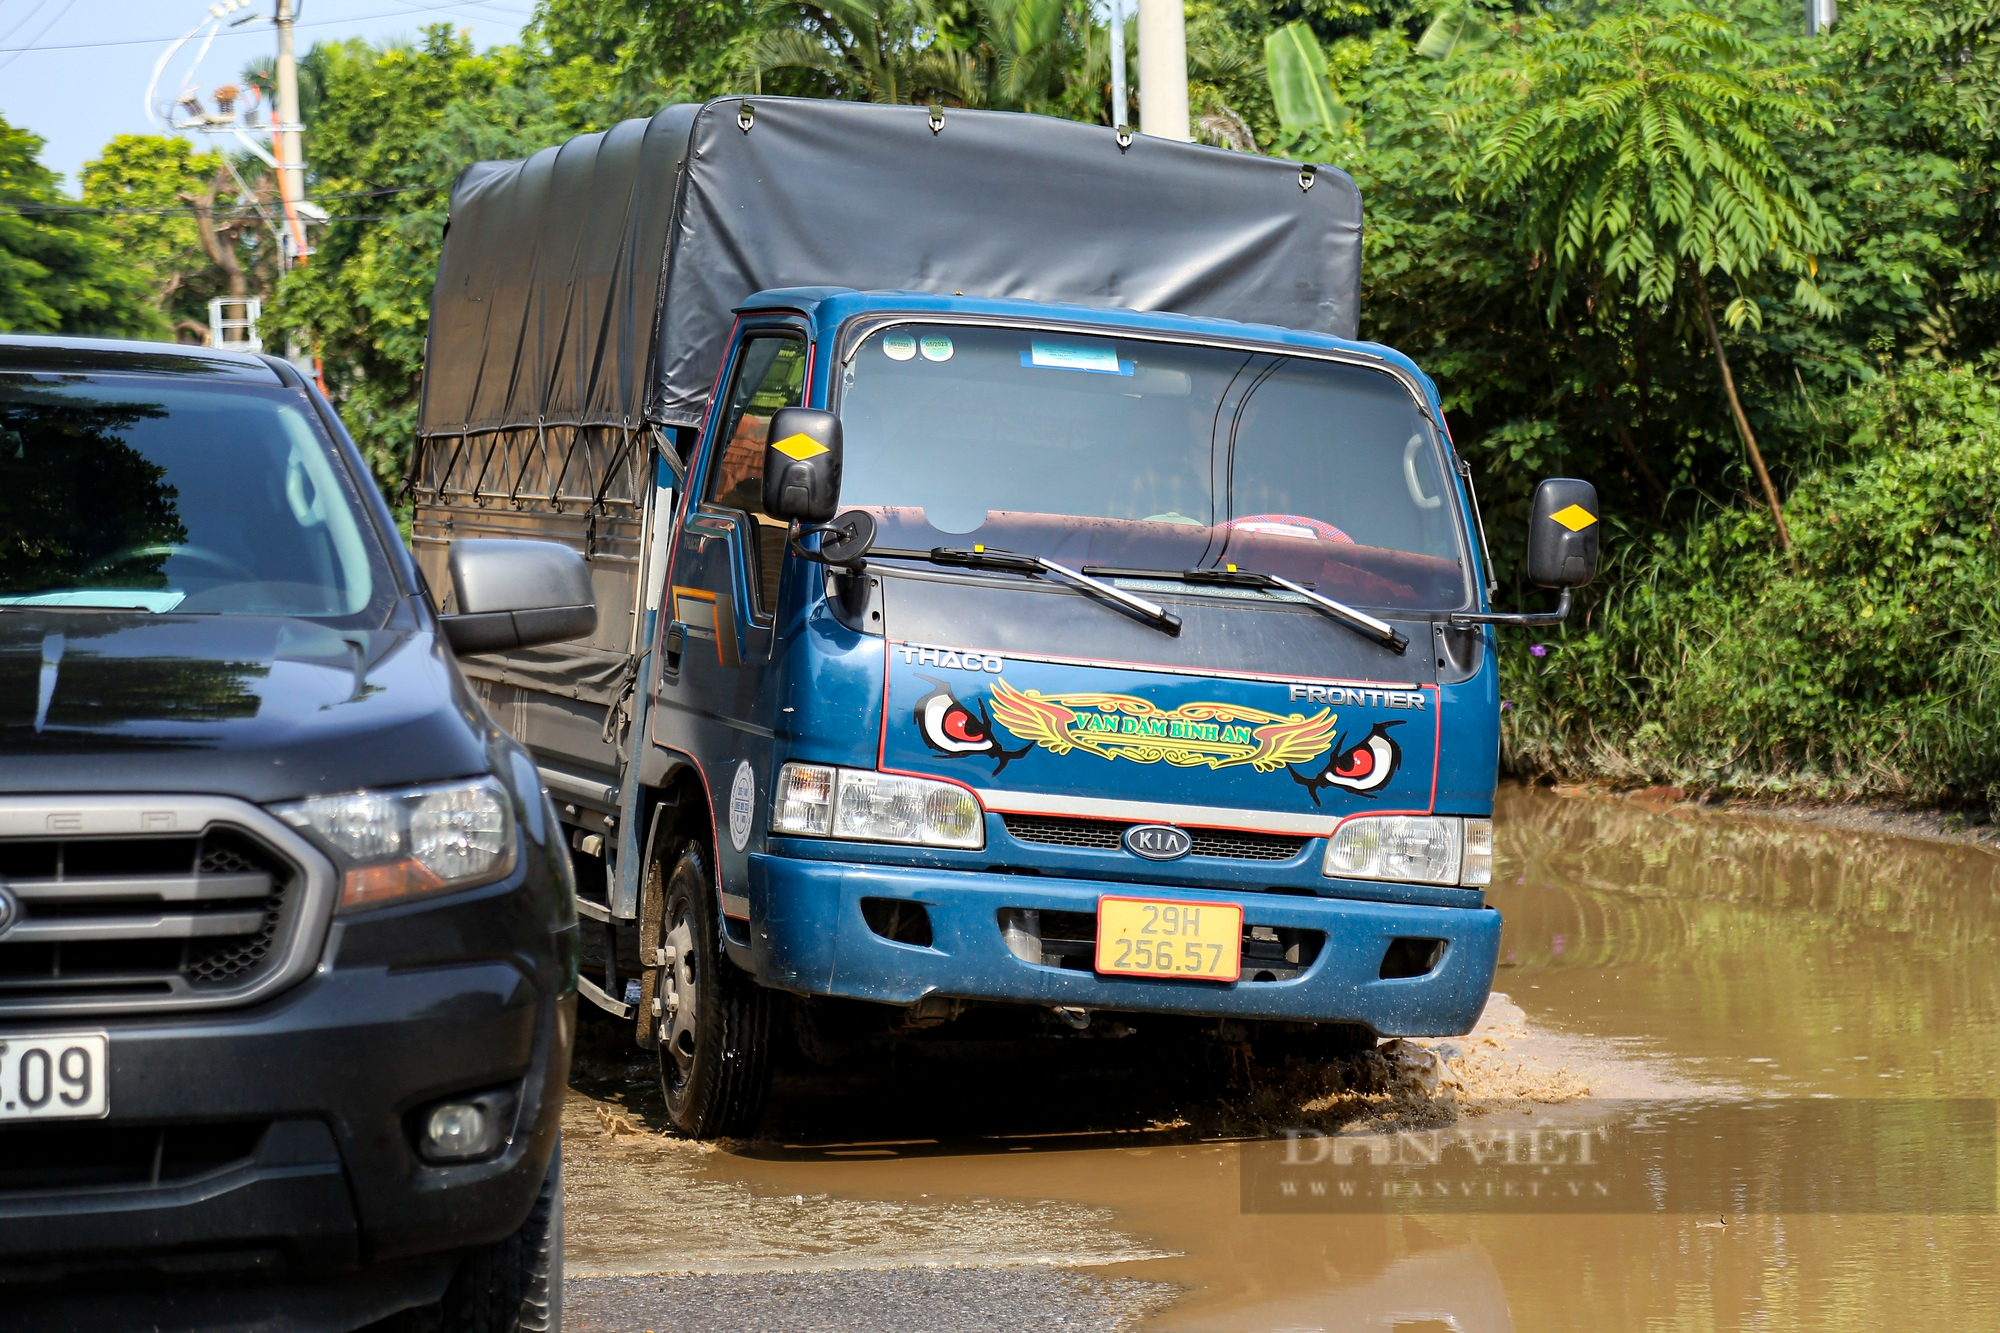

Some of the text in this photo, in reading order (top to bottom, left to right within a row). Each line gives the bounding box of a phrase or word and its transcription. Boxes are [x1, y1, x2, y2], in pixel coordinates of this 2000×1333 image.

[899, 647, 1004, 674] THACO
[1289, 684, 1425, 711] FRONTIER
[1170, 719, 1219, 742] BÌNH
[1221, 725, 1252, 744] AN
[1139, 832, 1180, 851] KIA
[1141, 905, 1200, 937] 29H
[1113, 938, 1224, 973] 256.57
